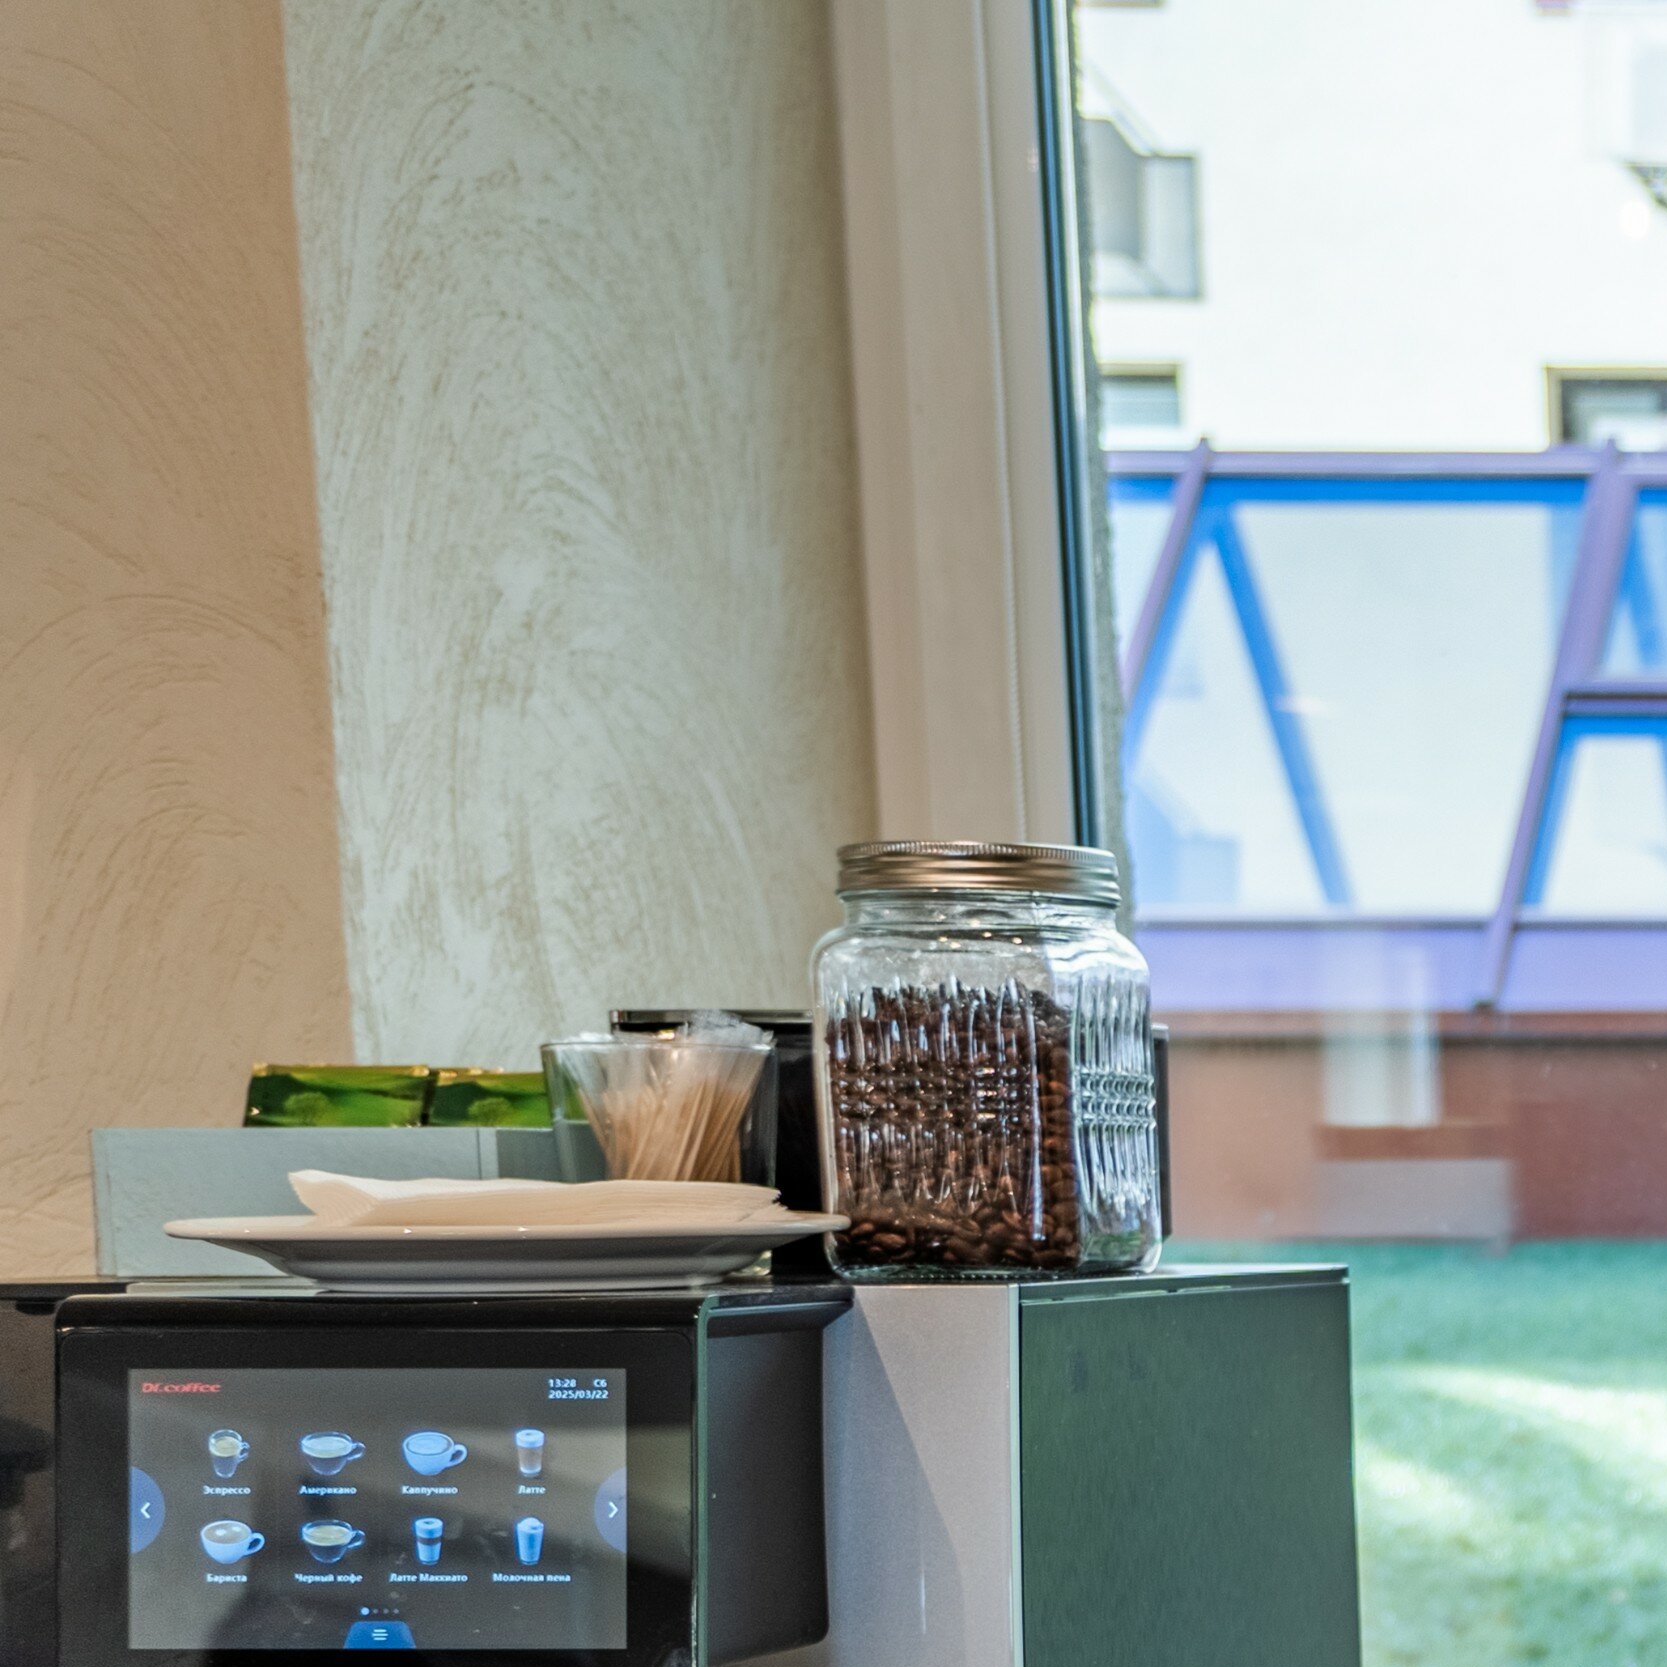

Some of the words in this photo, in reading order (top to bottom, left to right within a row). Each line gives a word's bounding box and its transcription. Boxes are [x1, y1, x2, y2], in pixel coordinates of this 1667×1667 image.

[548, 1378, 577, 1388] 13:28
[548, 1389, 609, 1400] 2025/03/22
[202, 1485, 251, 1496] Эспрессо
[298, 1485, 358, 1496] Американо
[517, 1484, 547, 1495] Латте
[206, 1573, 248, 1584] Бариста
[336, 1573, 363, 1584] кофе
[388, 1572, 418, 1582] Латте
